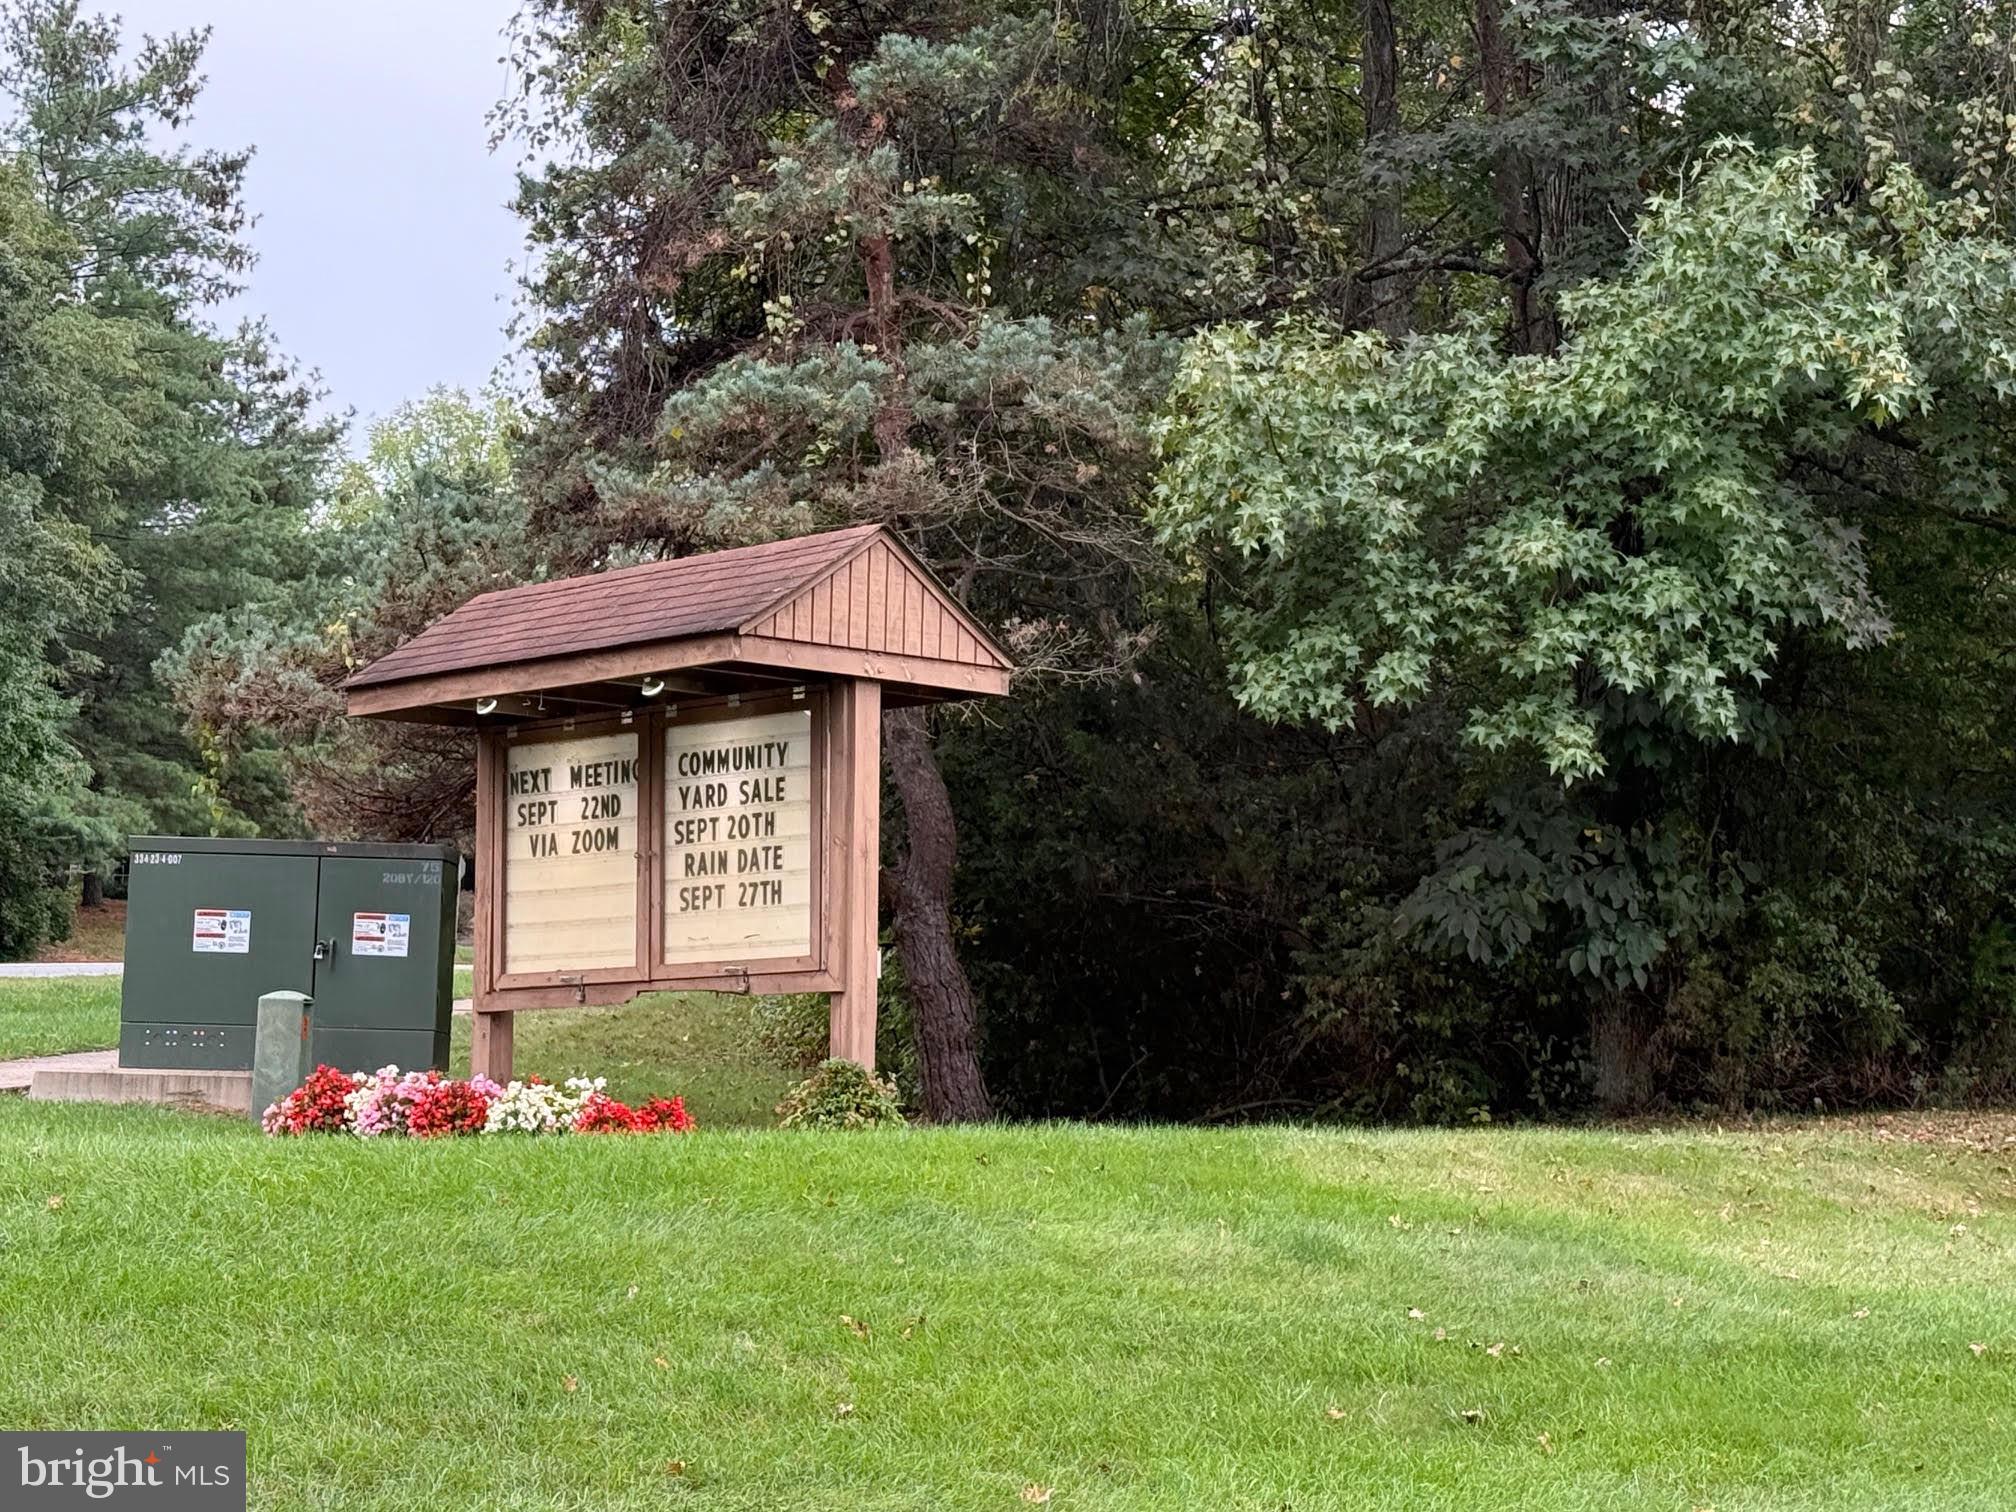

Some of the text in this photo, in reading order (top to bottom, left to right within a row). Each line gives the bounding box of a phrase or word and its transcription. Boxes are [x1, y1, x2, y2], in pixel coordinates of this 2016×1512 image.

[678, 742, 789, 777] COMMUNITY
[510, 767, 552, 795] NEXT
[678, 776, 786, 810] YARD SALE
[517, 794, 621, 827] SEPT 22ND
[529, 826, 619, 857] VIA ZOOM
[674, 811, 775, 845] SEPT 20TH
[684, 845, 783, 877] RAIN DATE
[679, 880, 782, 912] SEPT 27TH
